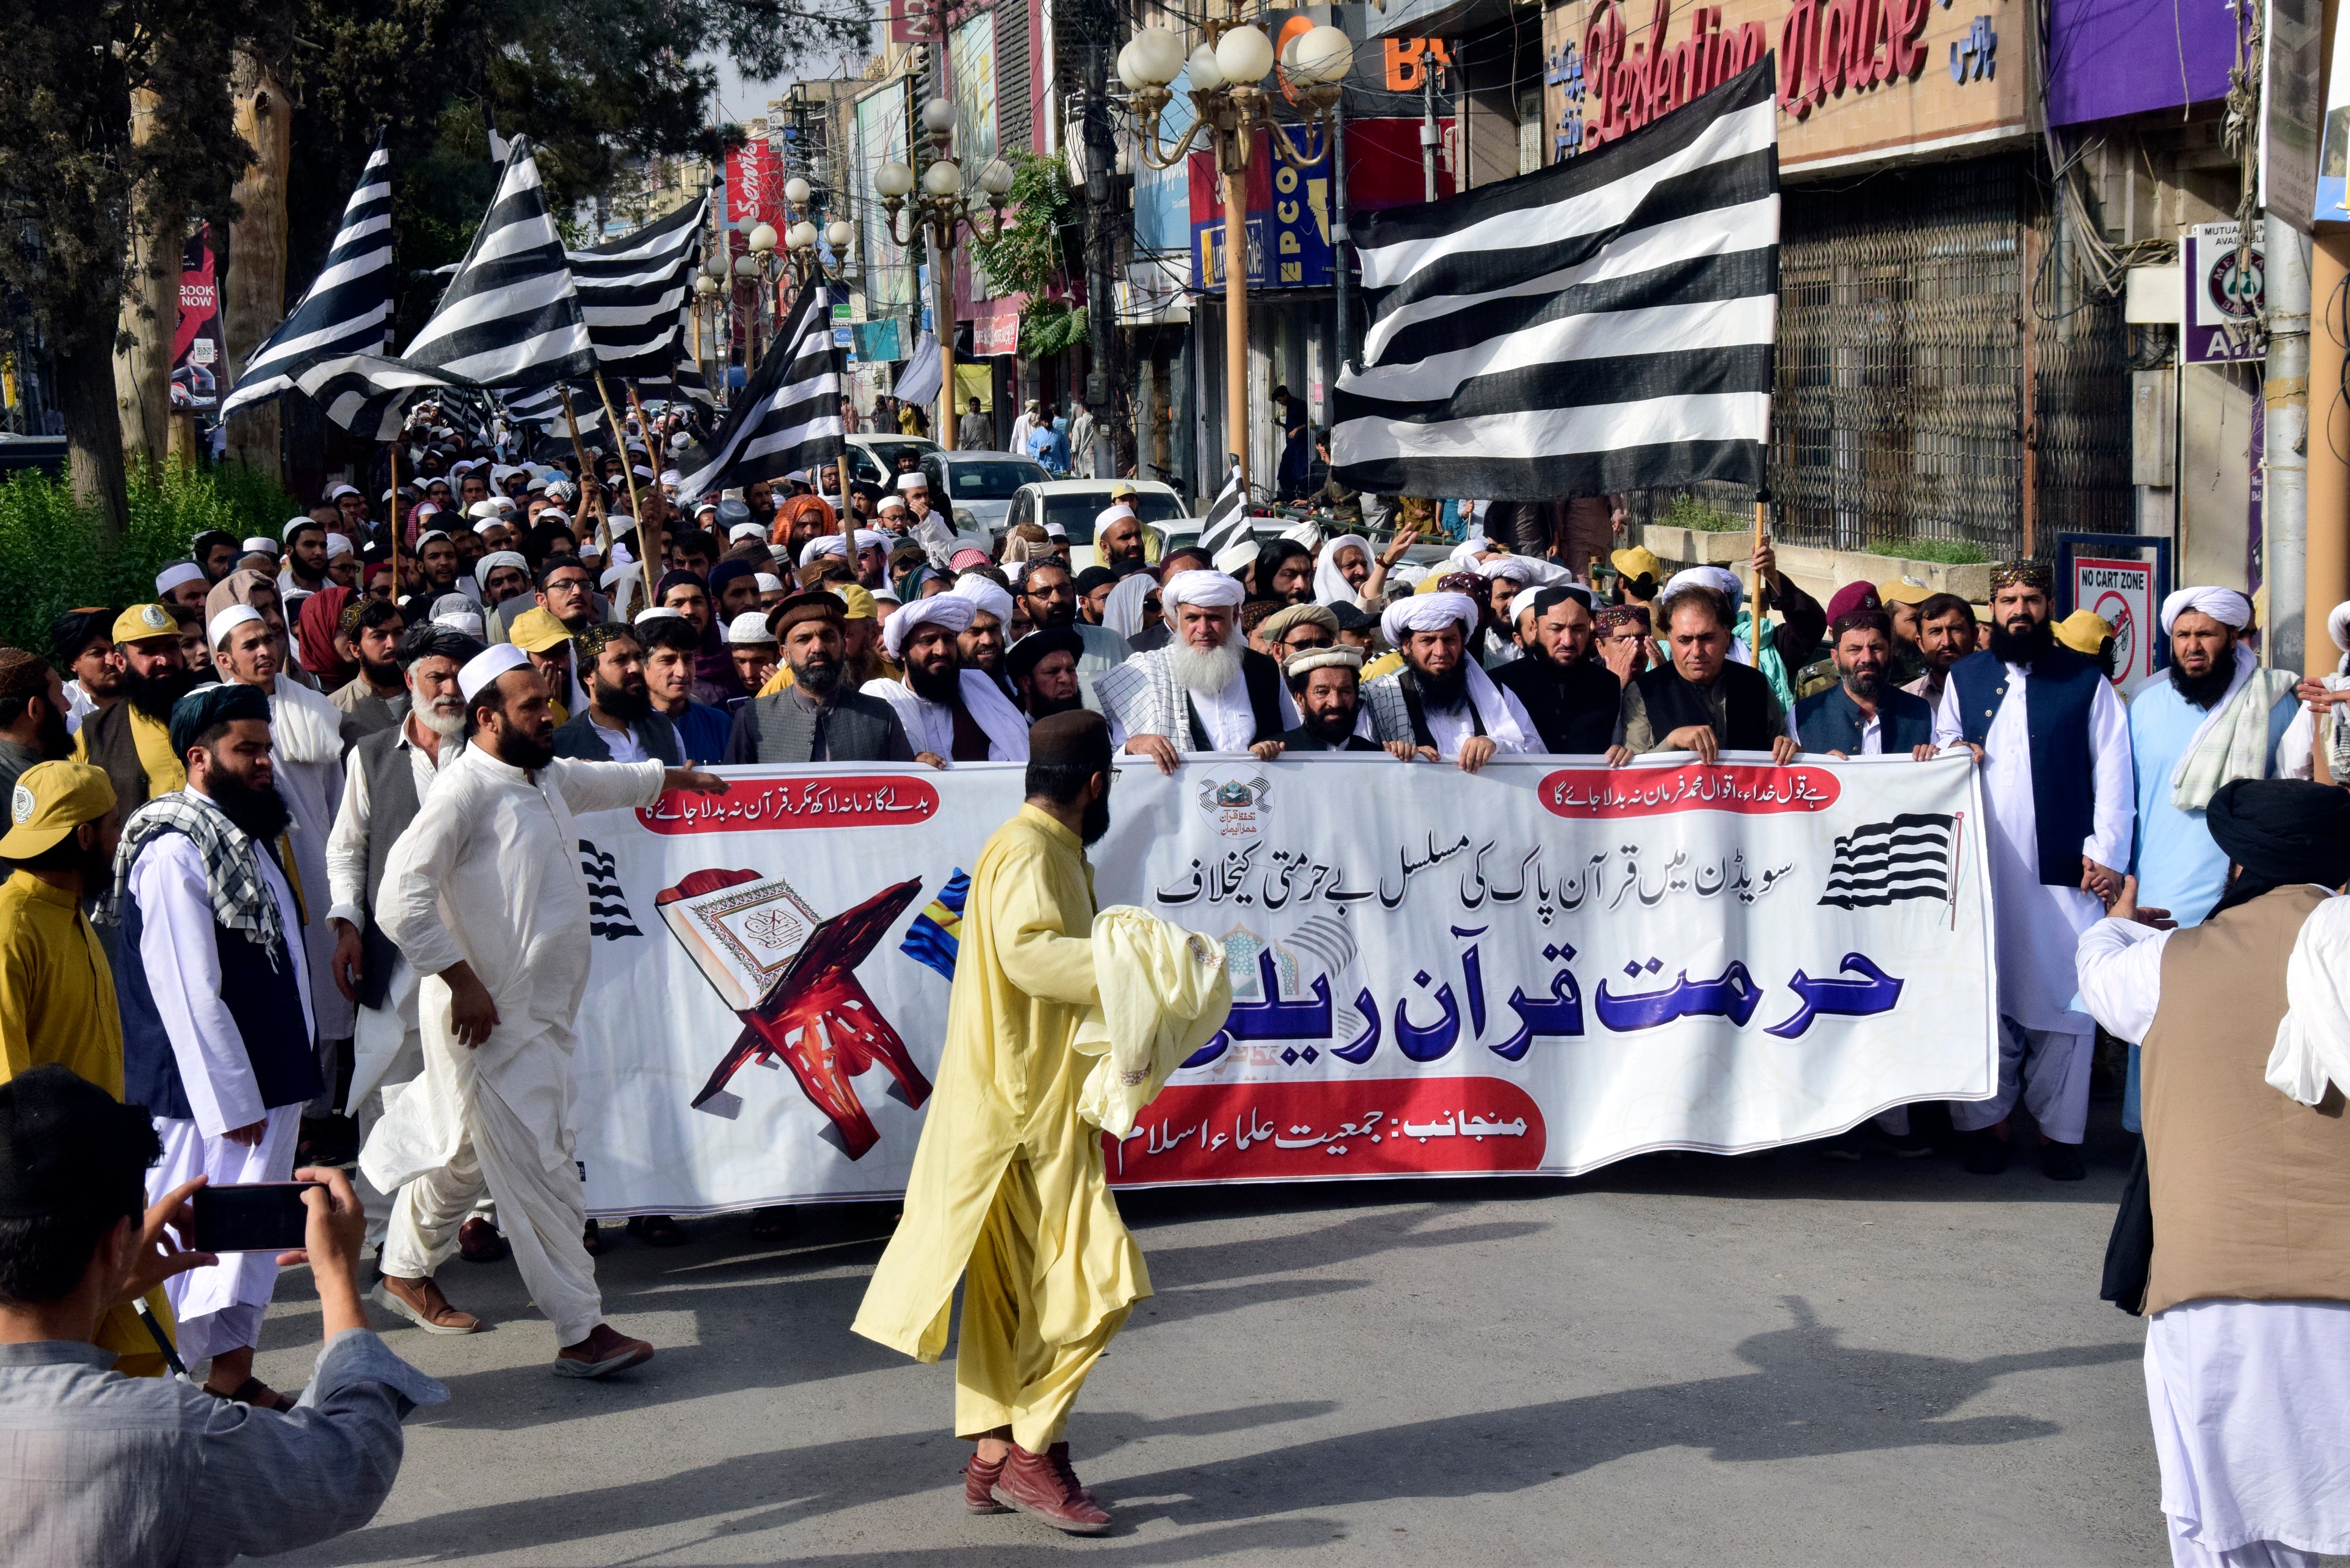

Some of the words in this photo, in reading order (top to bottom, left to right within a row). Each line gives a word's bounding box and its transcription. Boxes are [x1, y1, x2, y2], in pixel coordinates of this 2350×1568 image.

[1583, 0, 1765, 150] Perfection
[1777, 0, 1930, 117] House
[736, 142, 759, 220] Servis
[2205, 226, 2239, 235] MUTUA
[179, 285, 214, 296] BOOK
[182, 295, 212, 307] NOW
[2082, 570, 2093, 586] NO
[2096, 570, 2118, 589] CART
[2121, 572, 2144, 590] ZONE
[810, 787, 837, 814] لاکھ
[875, 785, 888, 811] گا
[885, 787, 928, 814] بدلے
[1554, 780, 1567, 805] گا
[1565, 786, 1600, 812] جائے
[1604, 787, 1626, 810] بدلا
[1627, 789, 1642, 805] نہ
[1644, 775, 1685, 805] فرمان
[1682, 775, 1702, 799] محمد
[1777, 775, 1807, 804] قول
[1802, 788, 1829, 809] ہے
[655, 799, 698, 826] جائے
[701, 797, 725, 822] بدلا
[727, 801, 743, 817] نہ
[744, 787, 789, 820] قرآن
[838, 793, 872, 813] زمانہ
[1219, 809, 1238, 823] قرآن
[1238, 811, 1256, 821] تحفظ
[1220, 823, 1239, 836] ایمان
[1262, 851, 1330, 910] حرمتی
[1379, 831, 1470, 908] مسلسل
[1460, 840, 1495, 909] کی
[1559, 844, 1639, 910] قرآن
[1638, 848, 1687, 907] میں
[1698, 847, 1794, 905] سویڈن
[1324, 867, 1374, 916] بے
[1491, 845, 1554, 926] پاک
[1394, 924, 1586, 1063] قرآن
[1595, 952, 1905, 1039] حرمت
[1211, 1106, 1274, 1152] علماء
[1275, 1111, 1384, 1155] جمعیت
[1117, 1117, 1208, 1176] اسلام
